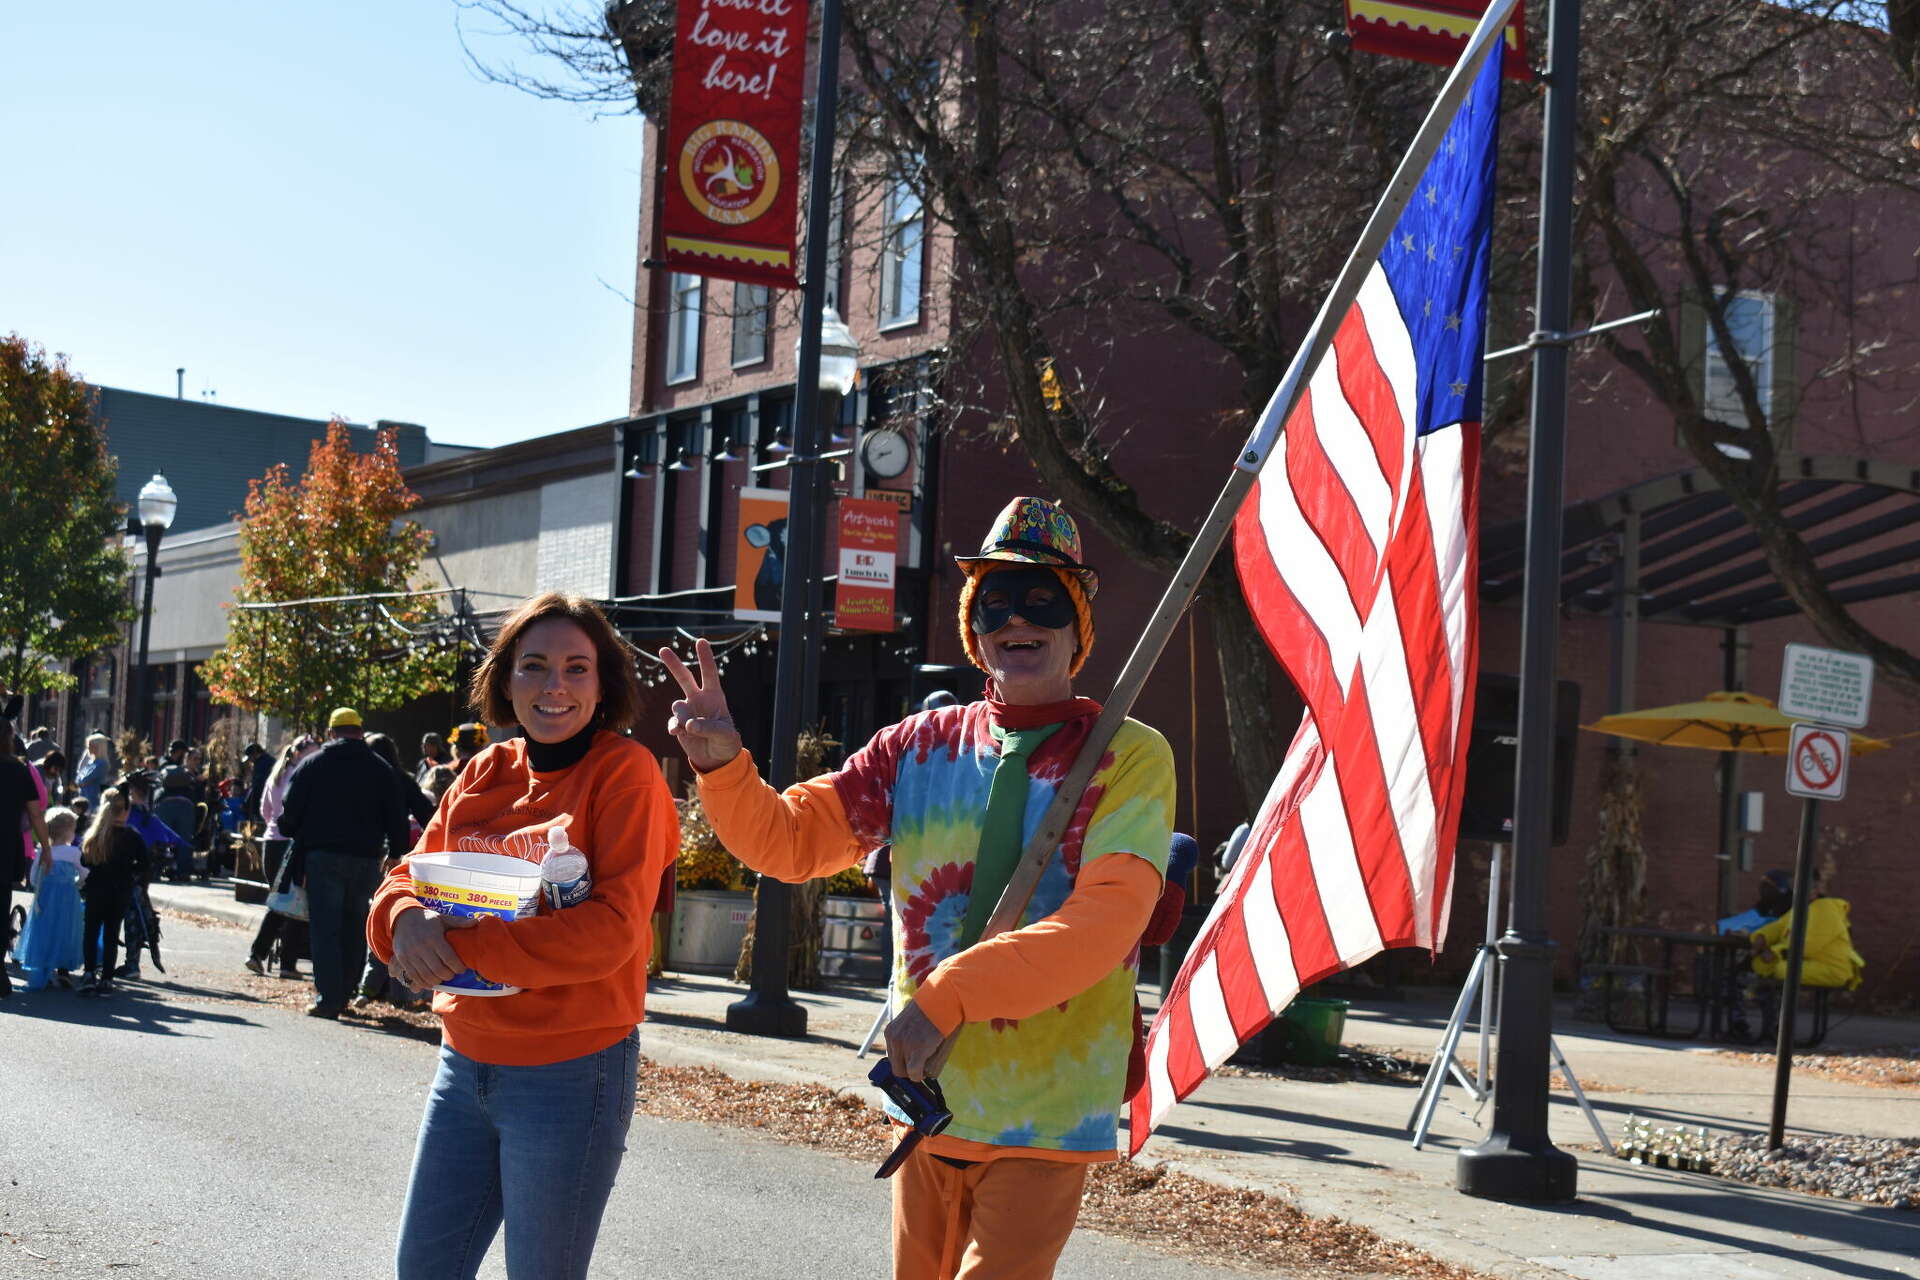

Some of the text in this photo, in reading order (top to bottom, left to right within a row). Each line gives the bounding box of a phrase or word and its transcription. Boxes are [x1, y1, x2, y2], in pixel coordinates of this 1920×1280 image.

[688, 10, 791, 58] love it
[702, 53, 777, 100] here!
[423, 885, 439, 896] 380
[440, 891, 460, 900] PIECES
[467, 892, 488, 904] 380
[489, 899, 513, 907] PIECES
